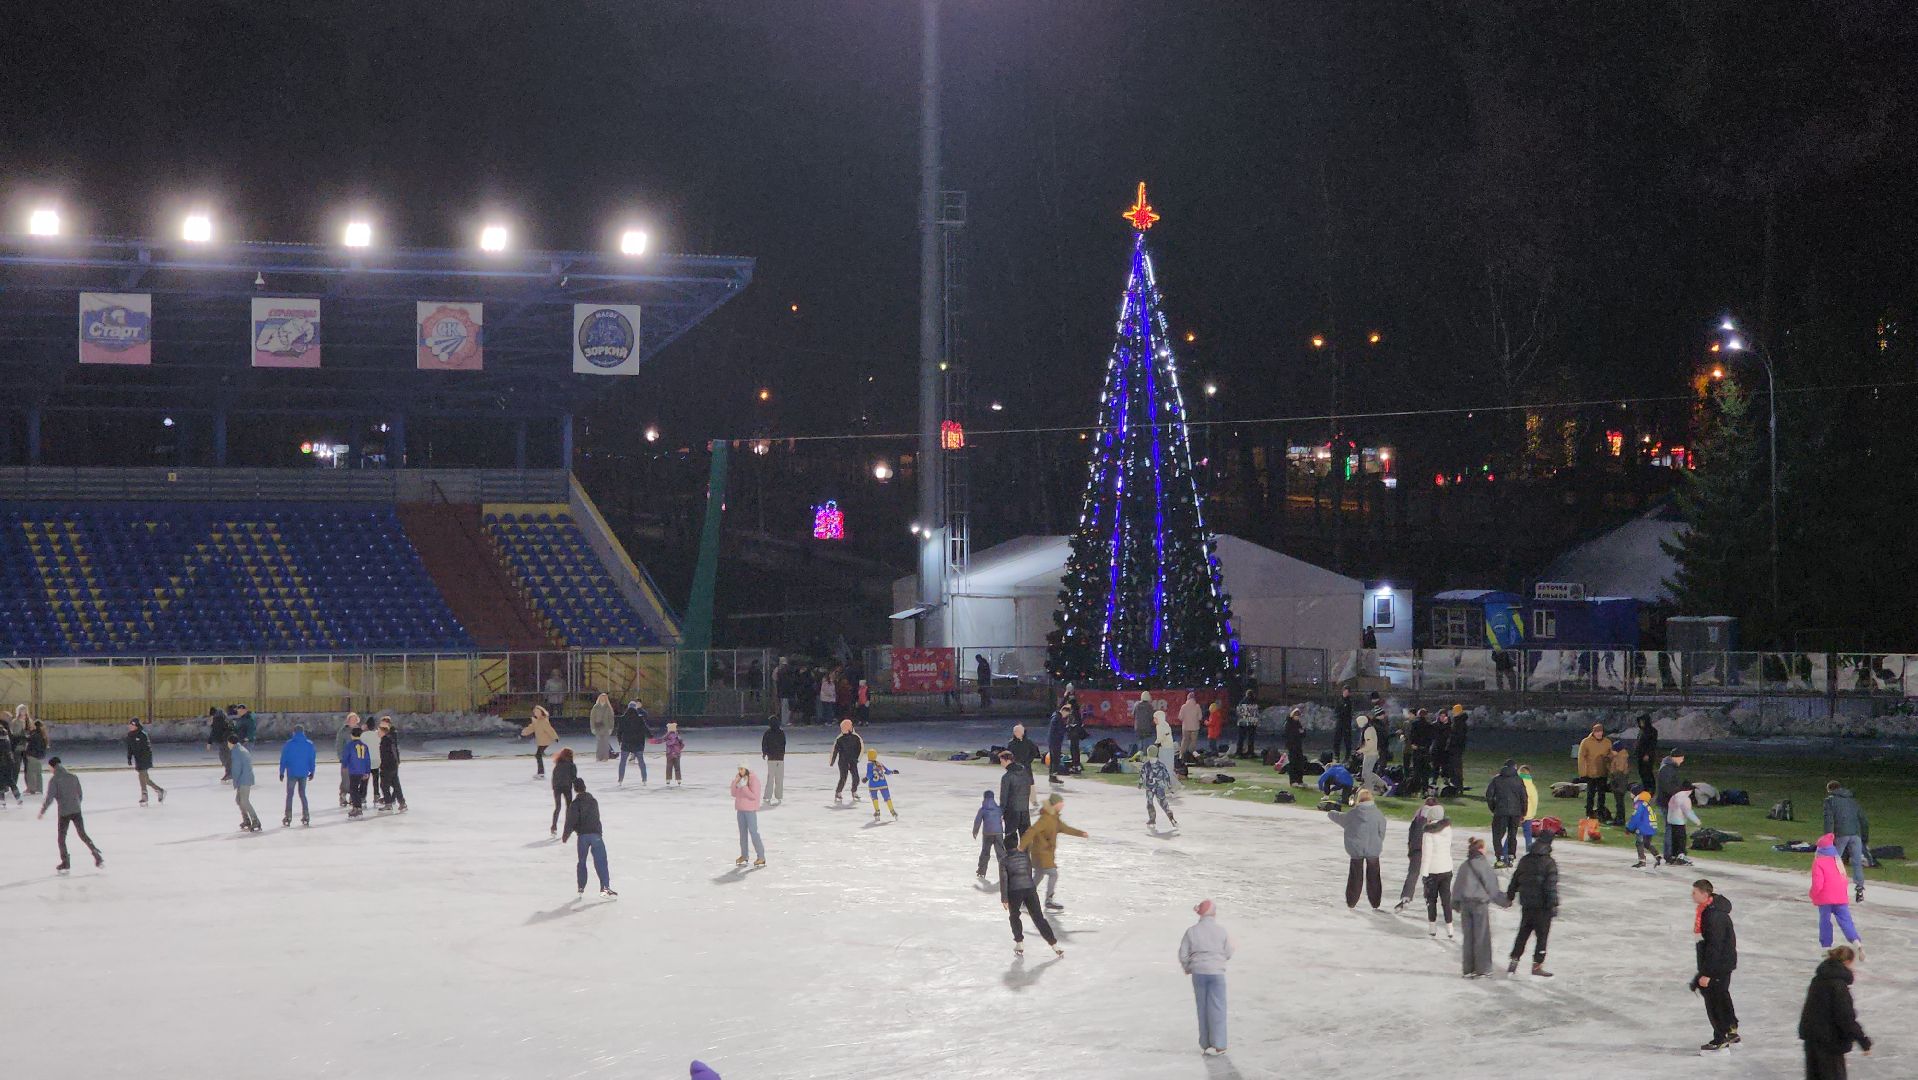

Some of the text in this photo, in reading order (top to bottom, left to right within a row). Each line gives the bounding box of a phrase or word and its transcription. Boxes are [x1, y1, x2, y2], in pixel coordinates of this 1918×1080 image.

[89, 321, 142, 337] Старт
[583, 345, 628, 360] ЗОРКИЙ
[907, 662, 937, 672] ЗИМА
[355, 743, 365, 759] 11
